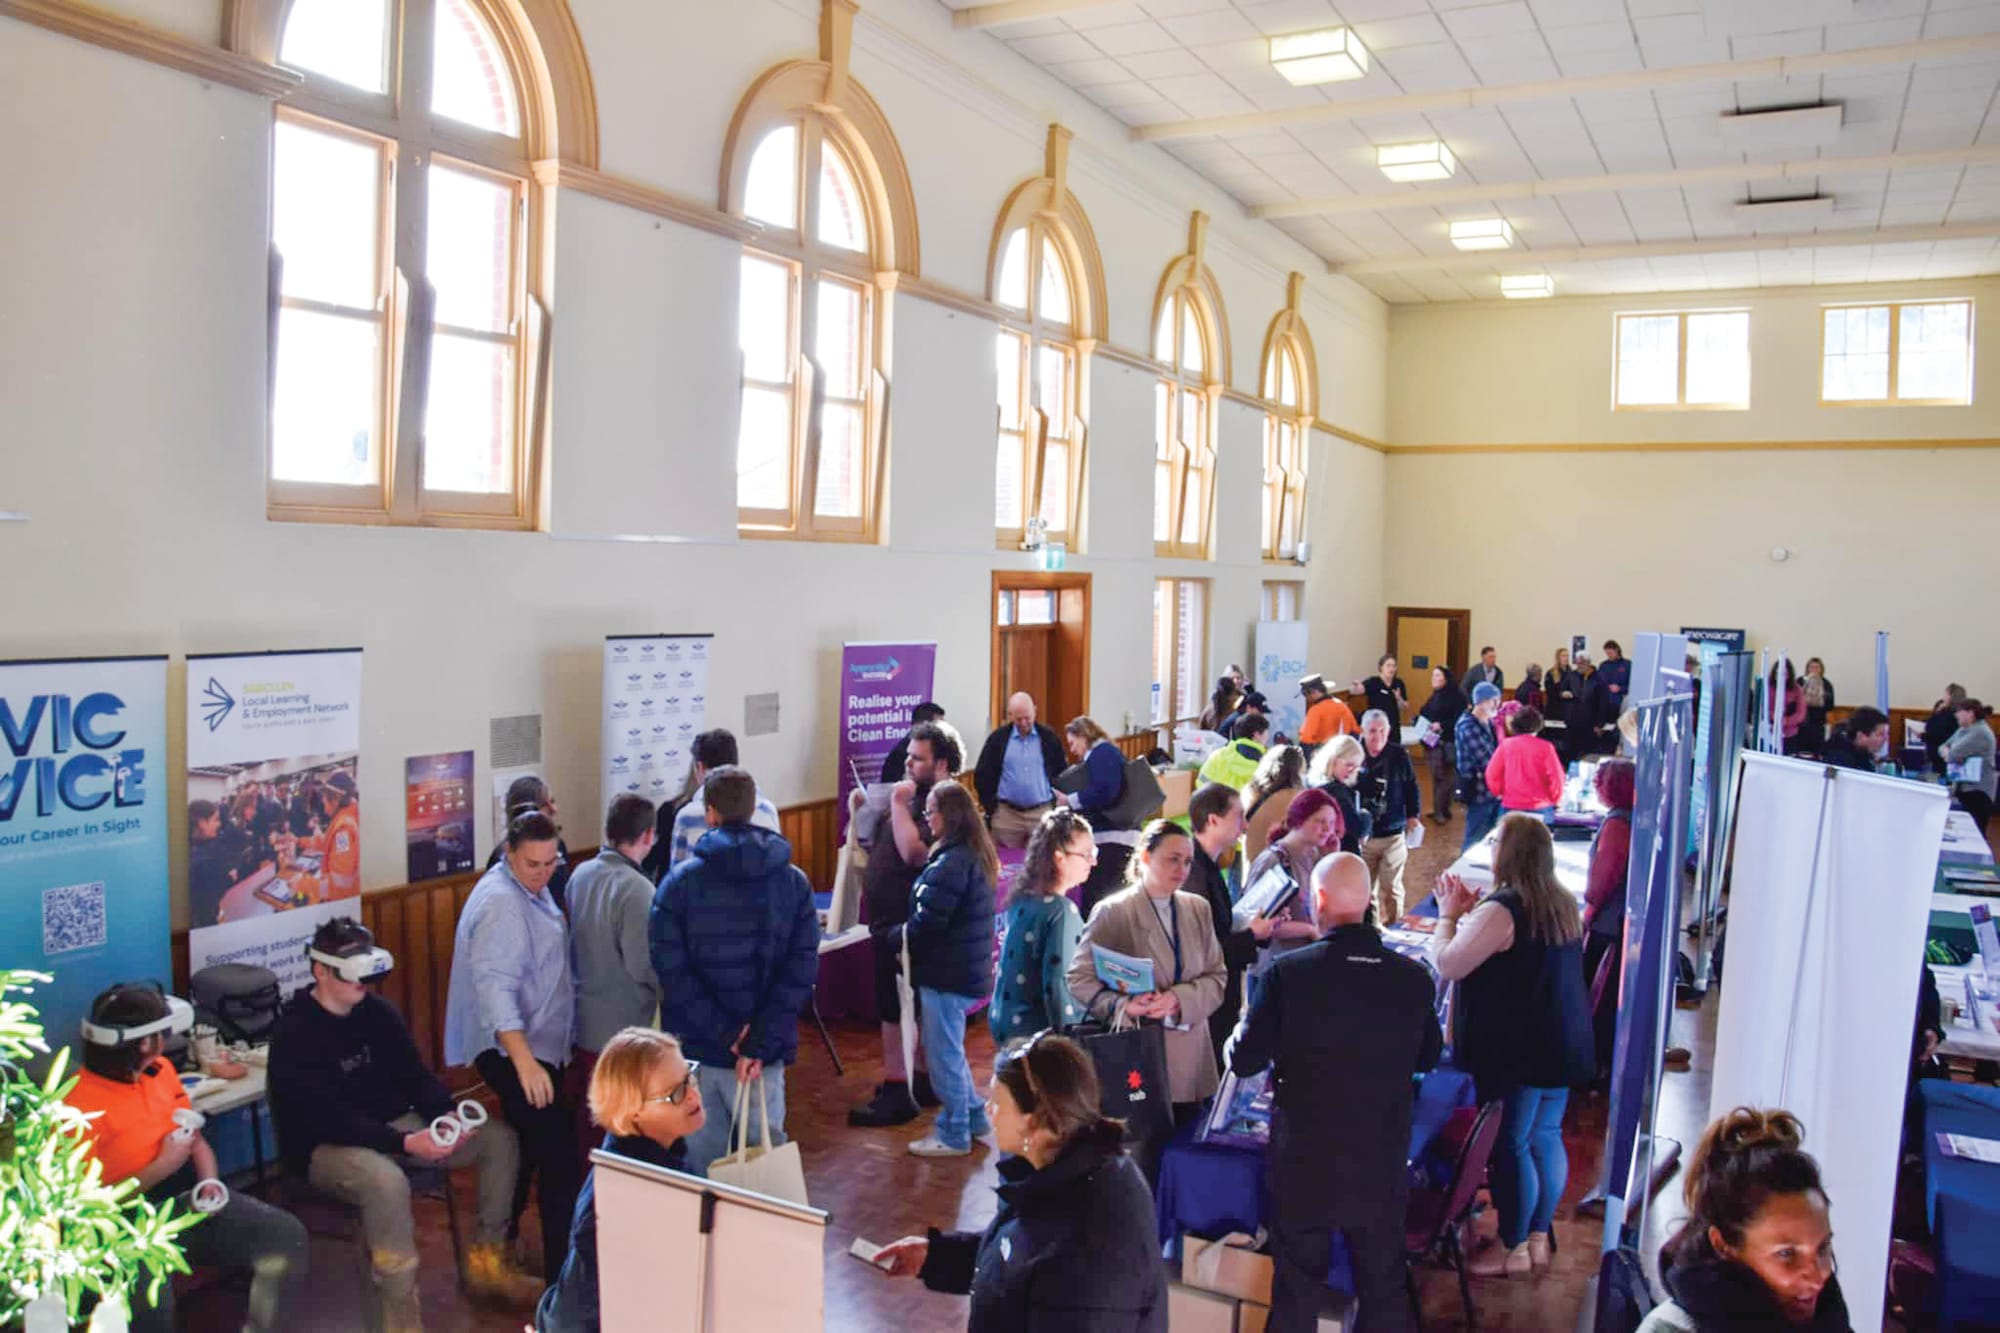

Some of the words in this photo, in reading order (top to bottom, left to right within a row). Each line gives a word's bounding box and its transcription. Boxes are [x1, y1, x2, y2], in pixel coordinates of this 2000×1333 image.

[242, 696, 268, 707] Local
[271, 693, 310, 705] Learning
[849, 694, 893, 709] Realise
[895, 694, 922, 709] your
[242, 710, 250, 719] &
[252, 706, 312, 719] Employment
[314, 702, 349, 713] Network
[848, 710, 903, 729] potential
[848, 729, 883, 742] Clean
[31, 827, 79, 842] Career
[84, 823, 98, 835] In
[103, 818, 140, 834] Sight
[205, 944, 268, 965] Supporting
[1129, 1090, 1146, 1101] nab
